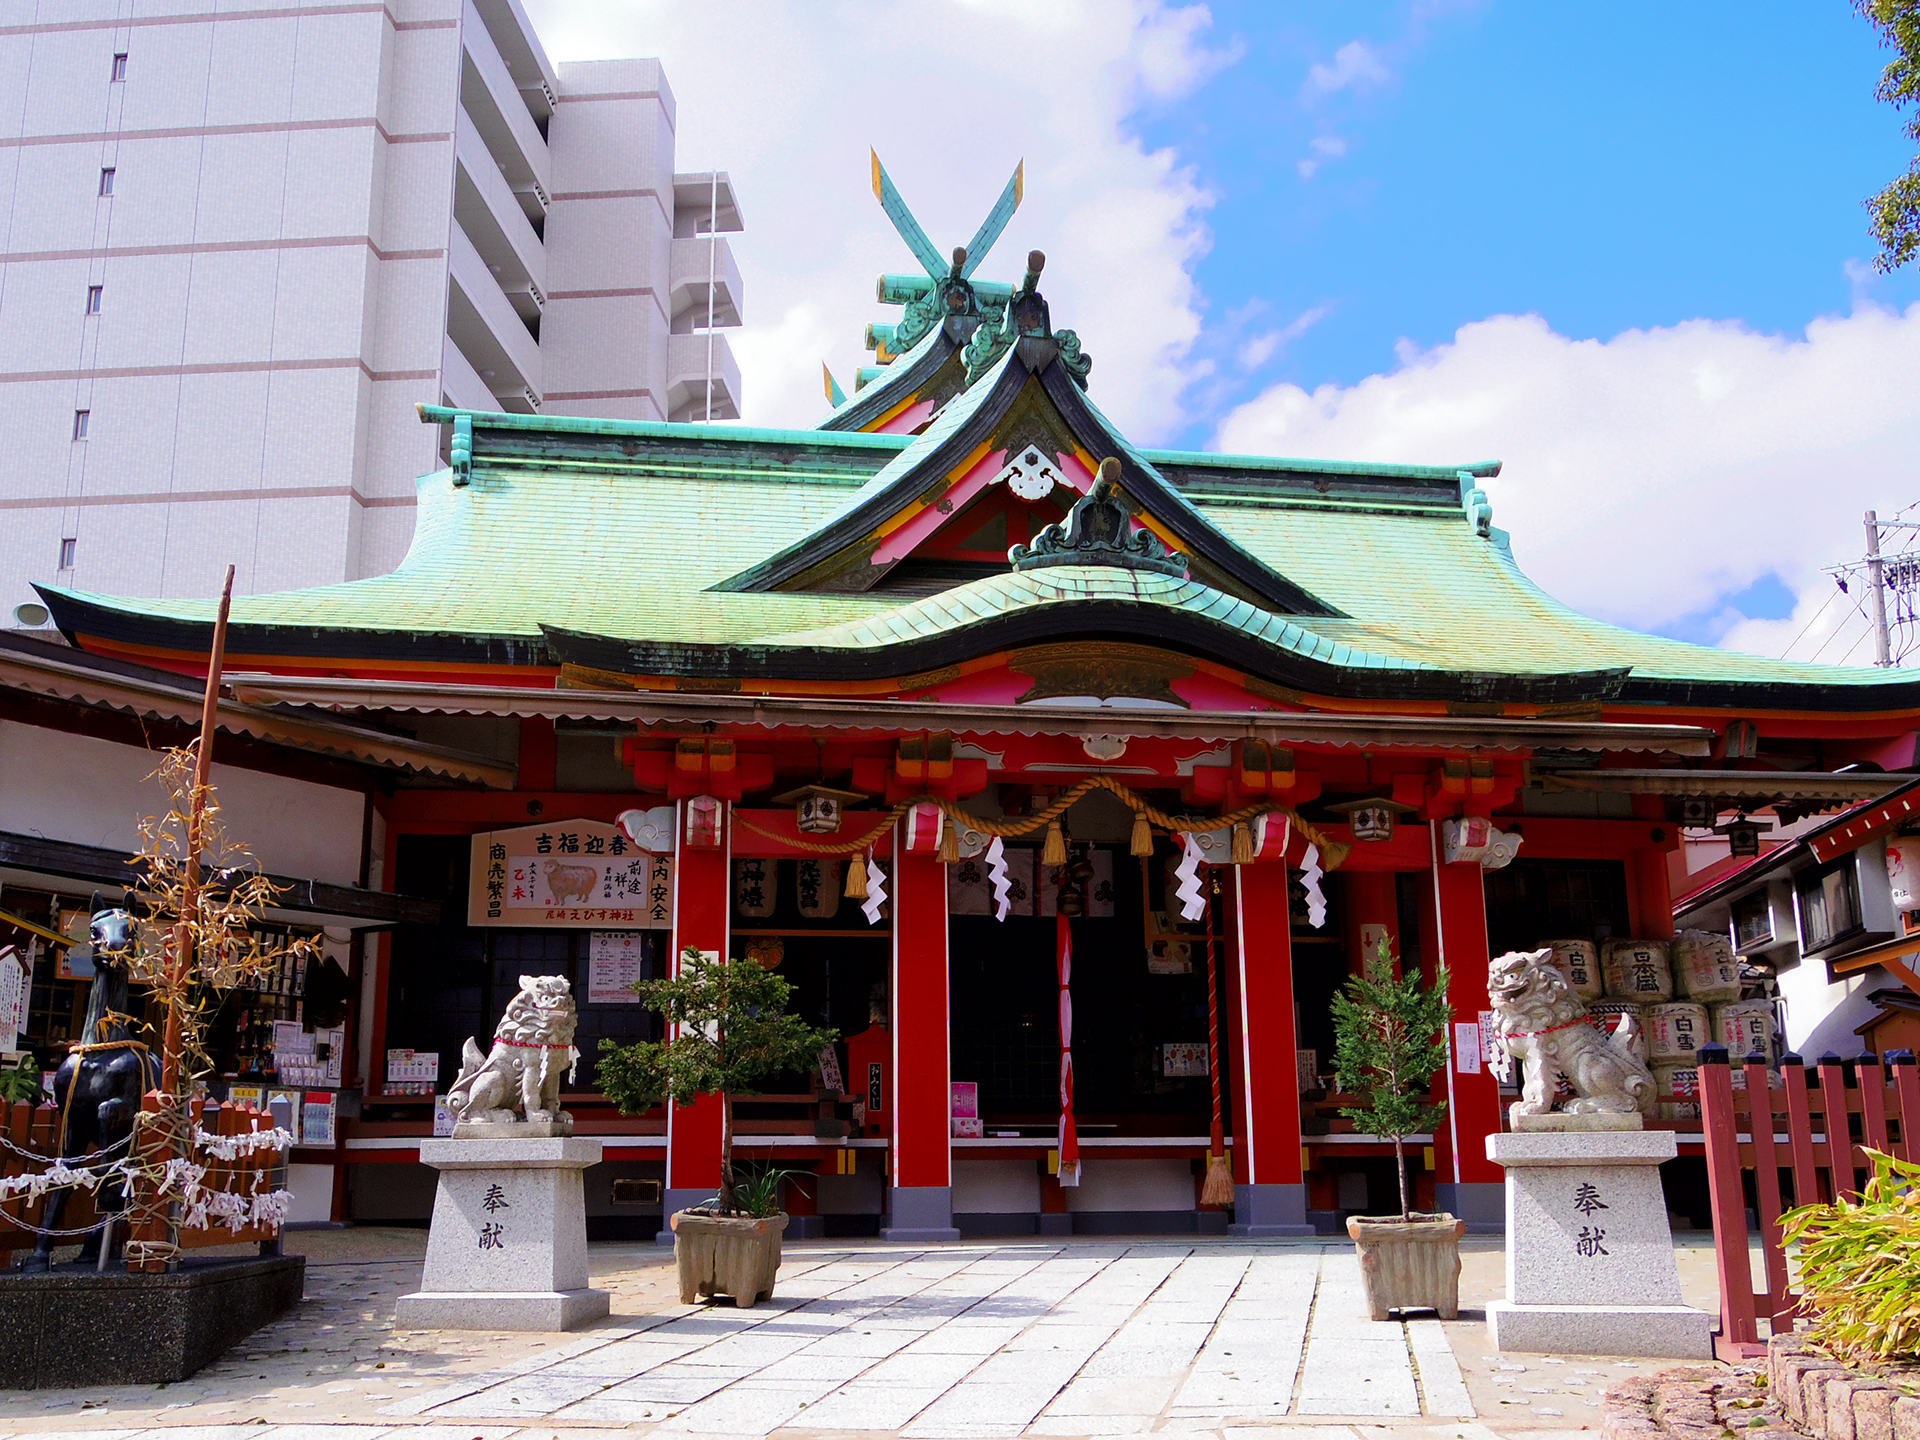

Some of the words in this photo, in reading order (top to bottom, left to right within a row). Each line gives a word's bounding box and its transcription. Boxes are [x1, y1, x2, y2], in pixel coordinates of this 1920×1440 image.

[534, 832, 628, 855] 吉福迎春
[486, 842, 506, 918] 商売繁昌
[511, 868, 526, 900] 乙未
[614, 872, 628, 899] 祥々
[627, 859, 642, 894] 前途
[1569, 951, 1588, 985] 白雪
[1631, 951, 1660, 992] 日本盛
[1675, 1015, 1696, 1051] 白雪
[1749, 1017, 1768, 1053] 白雪
[870, 1065, 880, 1109] おみくじ
[478, 1183, 510, 1250] 奉献
[1573, 1182, 1610, 1258] 奉献
